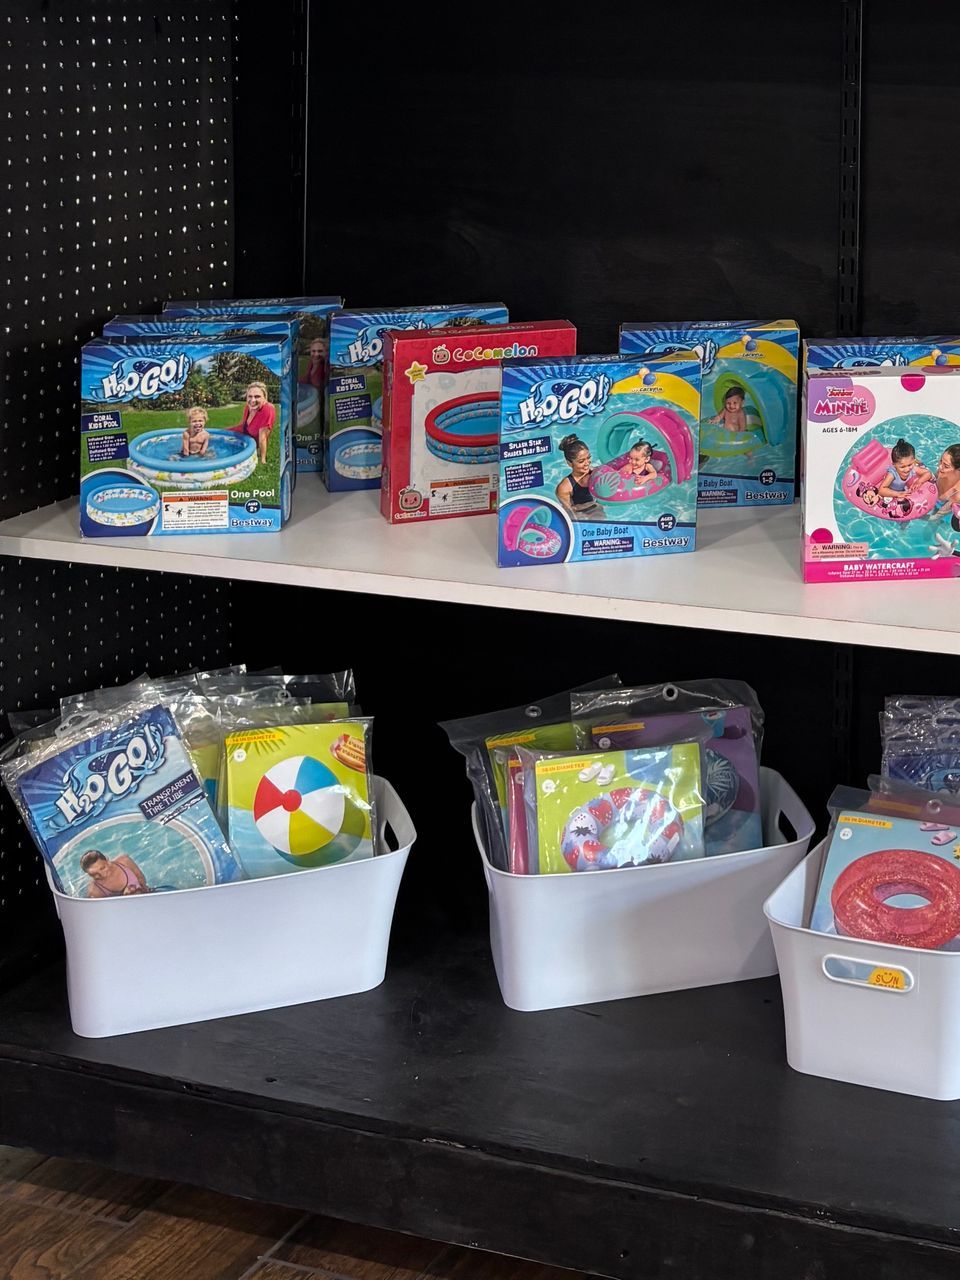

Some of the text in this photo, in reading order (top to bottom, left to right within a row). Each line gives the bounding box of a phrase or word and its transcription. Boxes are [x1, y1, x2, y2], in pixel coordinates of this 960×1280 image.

[453, 344, 538, 362] CoComelon
[814, 398, 868, 416] MINNIE
[94, 414, 113, 422] CORAL
[704, 480, 718, 488] Baby
[231, 489, 274, 498] One Pool
[745, 491, 788, 500] Bestway
[231, 518, 273, 526] Bestway
[582, 529, 595, 537] One
[596, 528, 612, 537] Baby
[643, 537, 689, 548] Bestway
[142, 773, 193, 809] TRANSPARENT
[146, 790, 185, 816] TIRE TUBE
[875, 974, 899, 985] SUN
